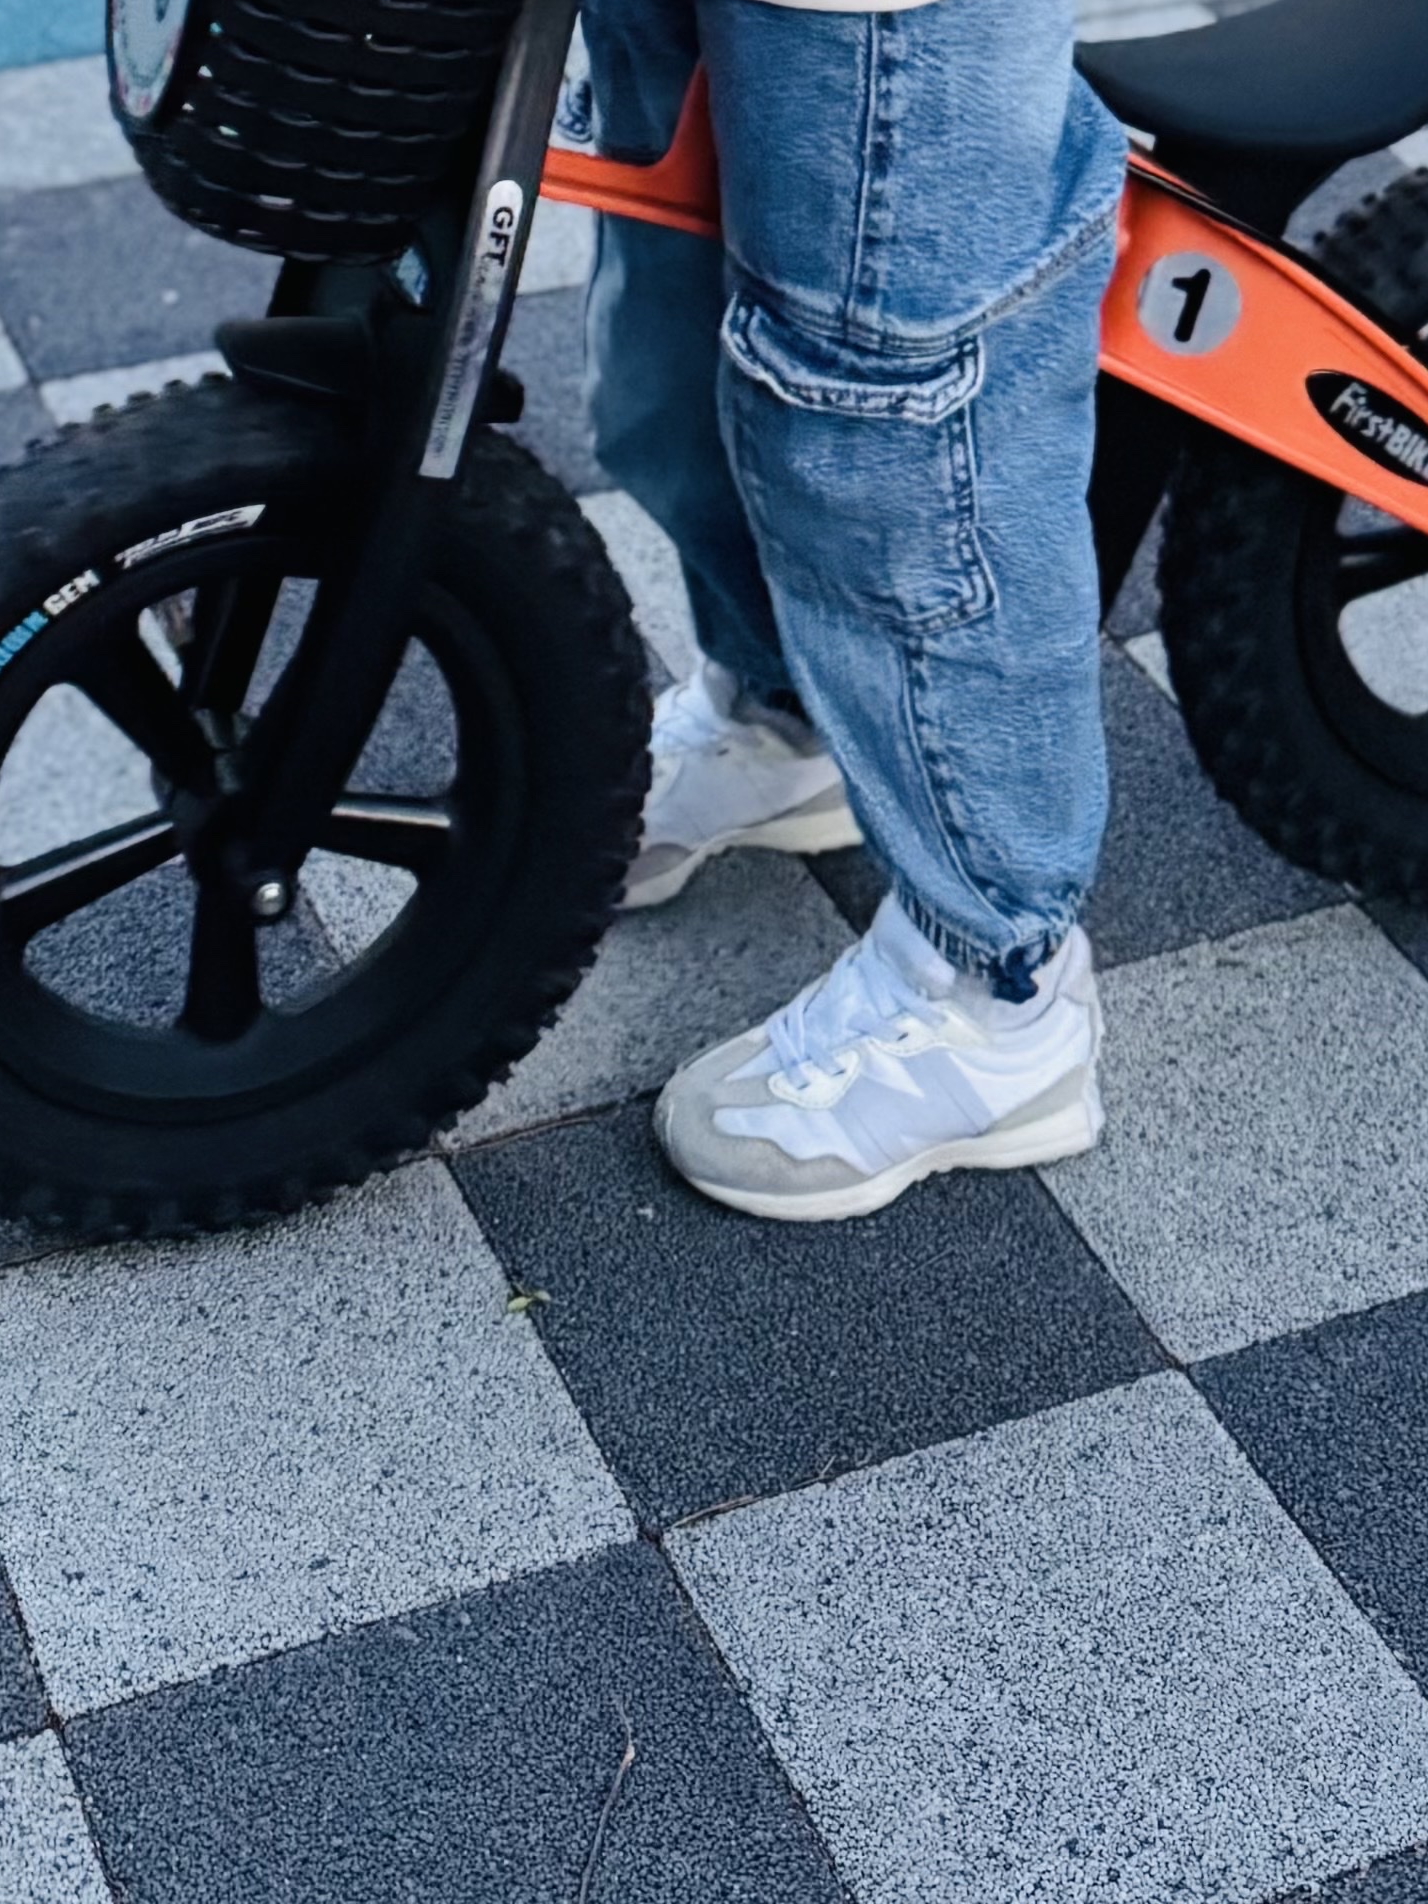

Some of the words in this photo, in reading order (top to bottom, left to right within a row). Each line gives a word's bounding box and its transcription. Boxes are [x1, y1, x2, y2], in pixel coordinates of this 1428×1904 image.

[487, 205, 517, 269] GFT
[1170, 267, 1213, 344] 1
[43, 569, 100, 616] GEM
